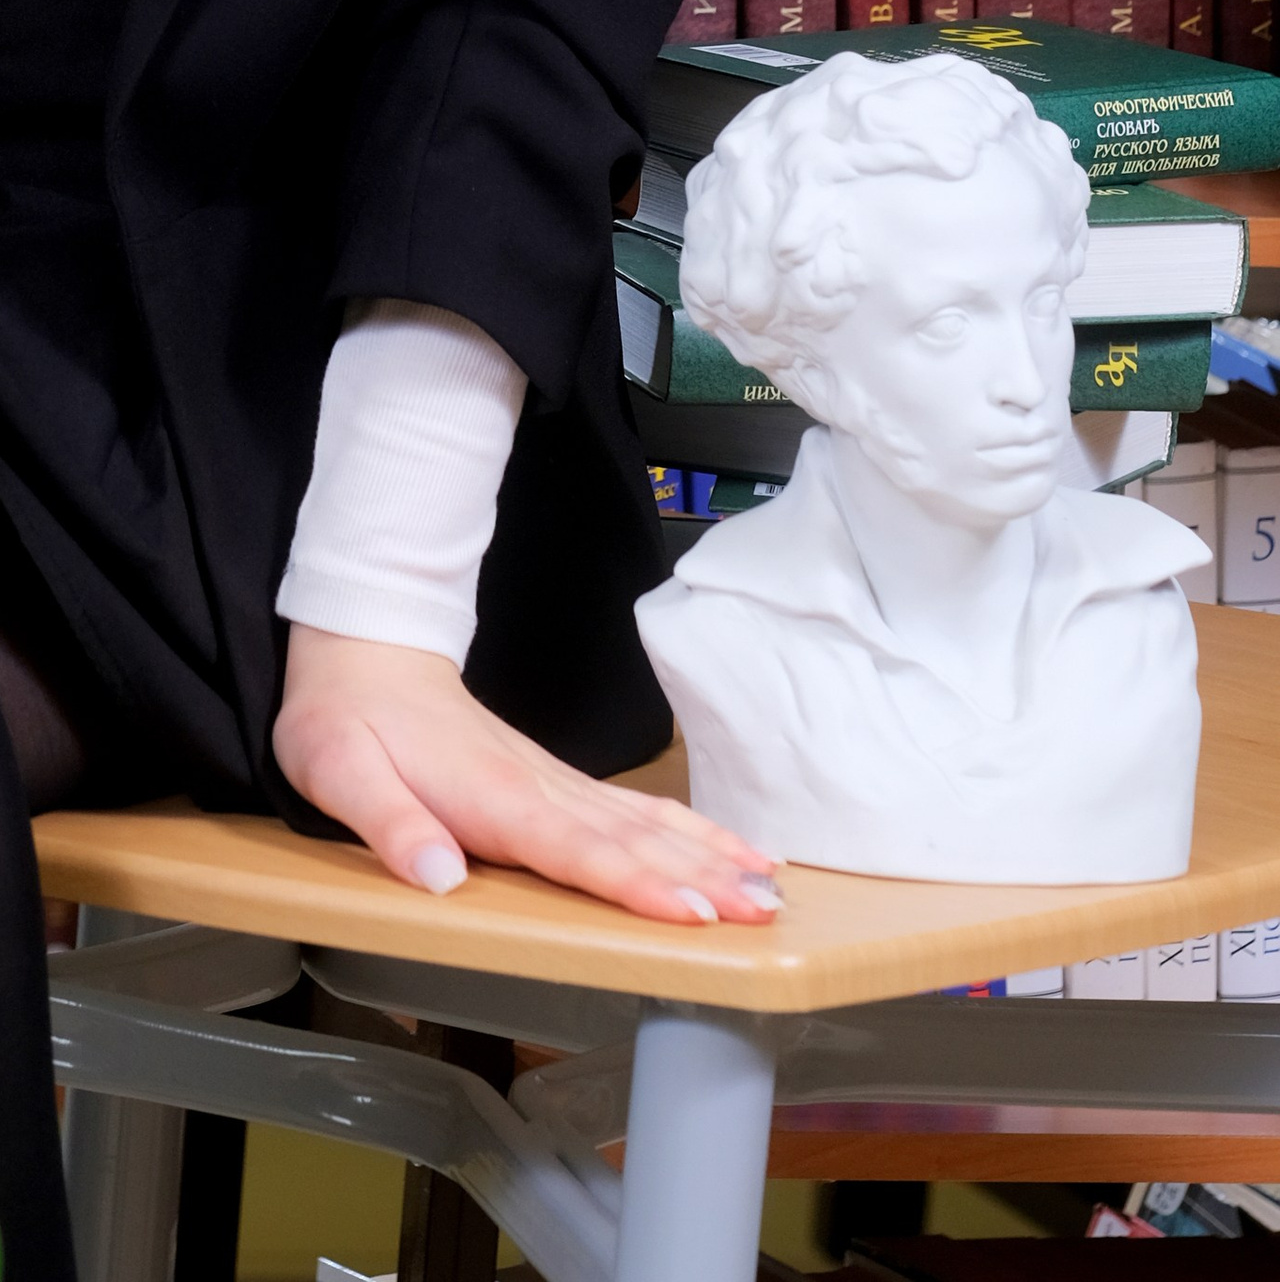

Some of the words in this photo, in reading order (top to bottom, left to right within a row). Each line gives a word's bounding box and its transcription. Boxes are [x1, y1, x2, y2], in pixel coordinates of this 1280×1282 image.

[1111, 1, 1133, 35] М.
[1179, 5, 1203, 37] А.
[1250, 11, 1274, 42] А.
[1094, 89, 1234, 117] ОРФОГРАФИЧЕСКИЙ
[1097, 119, 1160, 138] СЛОВАРЬ
[1094, 139, 1168, 158] РУССКОГО
[1173, 134, 1220, 152] ЯЗЫКА
[1088, 162, 1117, 178] ДЛЯ
[1121, 153, 1220, 174] ШКОЛЬНИКОВ
[1252, 516, 1277, 562] 5
